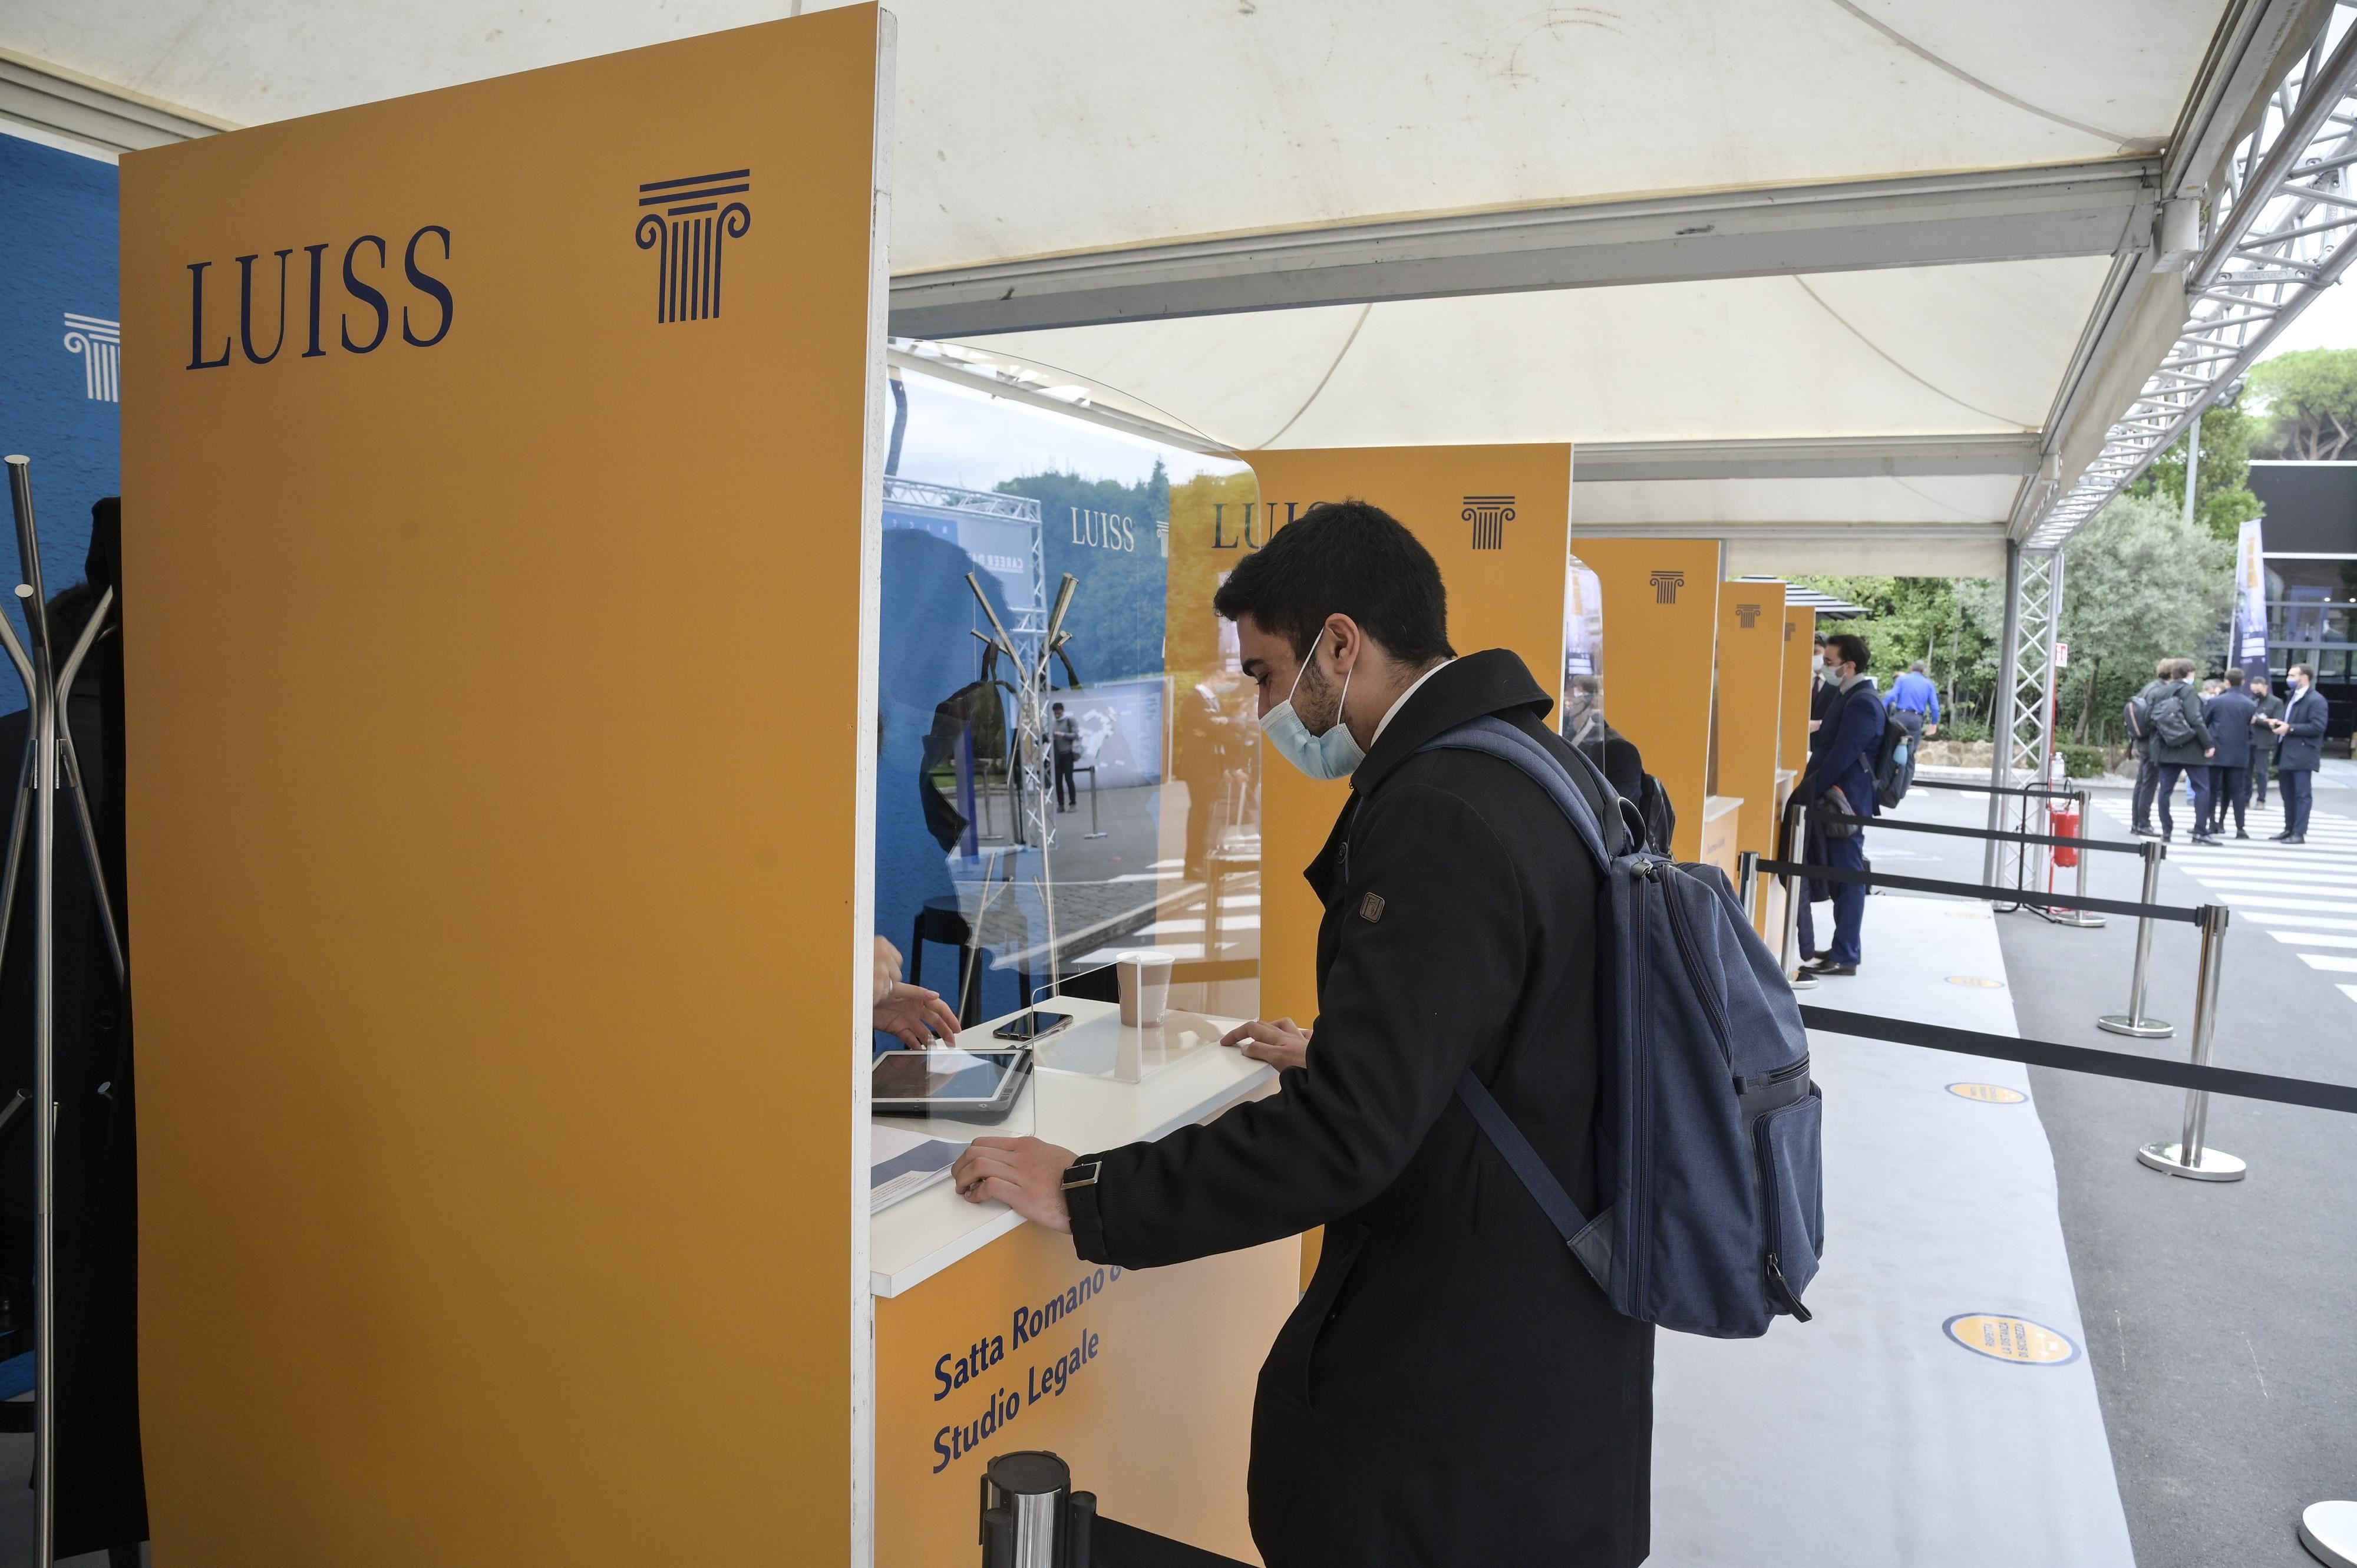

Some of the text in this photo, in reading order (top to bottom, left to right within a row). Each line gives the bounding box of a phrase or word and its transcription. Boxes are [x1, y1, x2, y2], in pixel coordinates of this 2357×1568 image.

[186, 225, 453, 370] LUISS
[1070, 507, 1134, 552] LUISS
[934, 1267, 1105, 1402] Satta Romano
[1984, 1323, 1995, 1347] RISPETTA
[1999, 1322, 2011, 1346] DISTANZA
[933, 1328, 1100, 1474] Studio Legale
